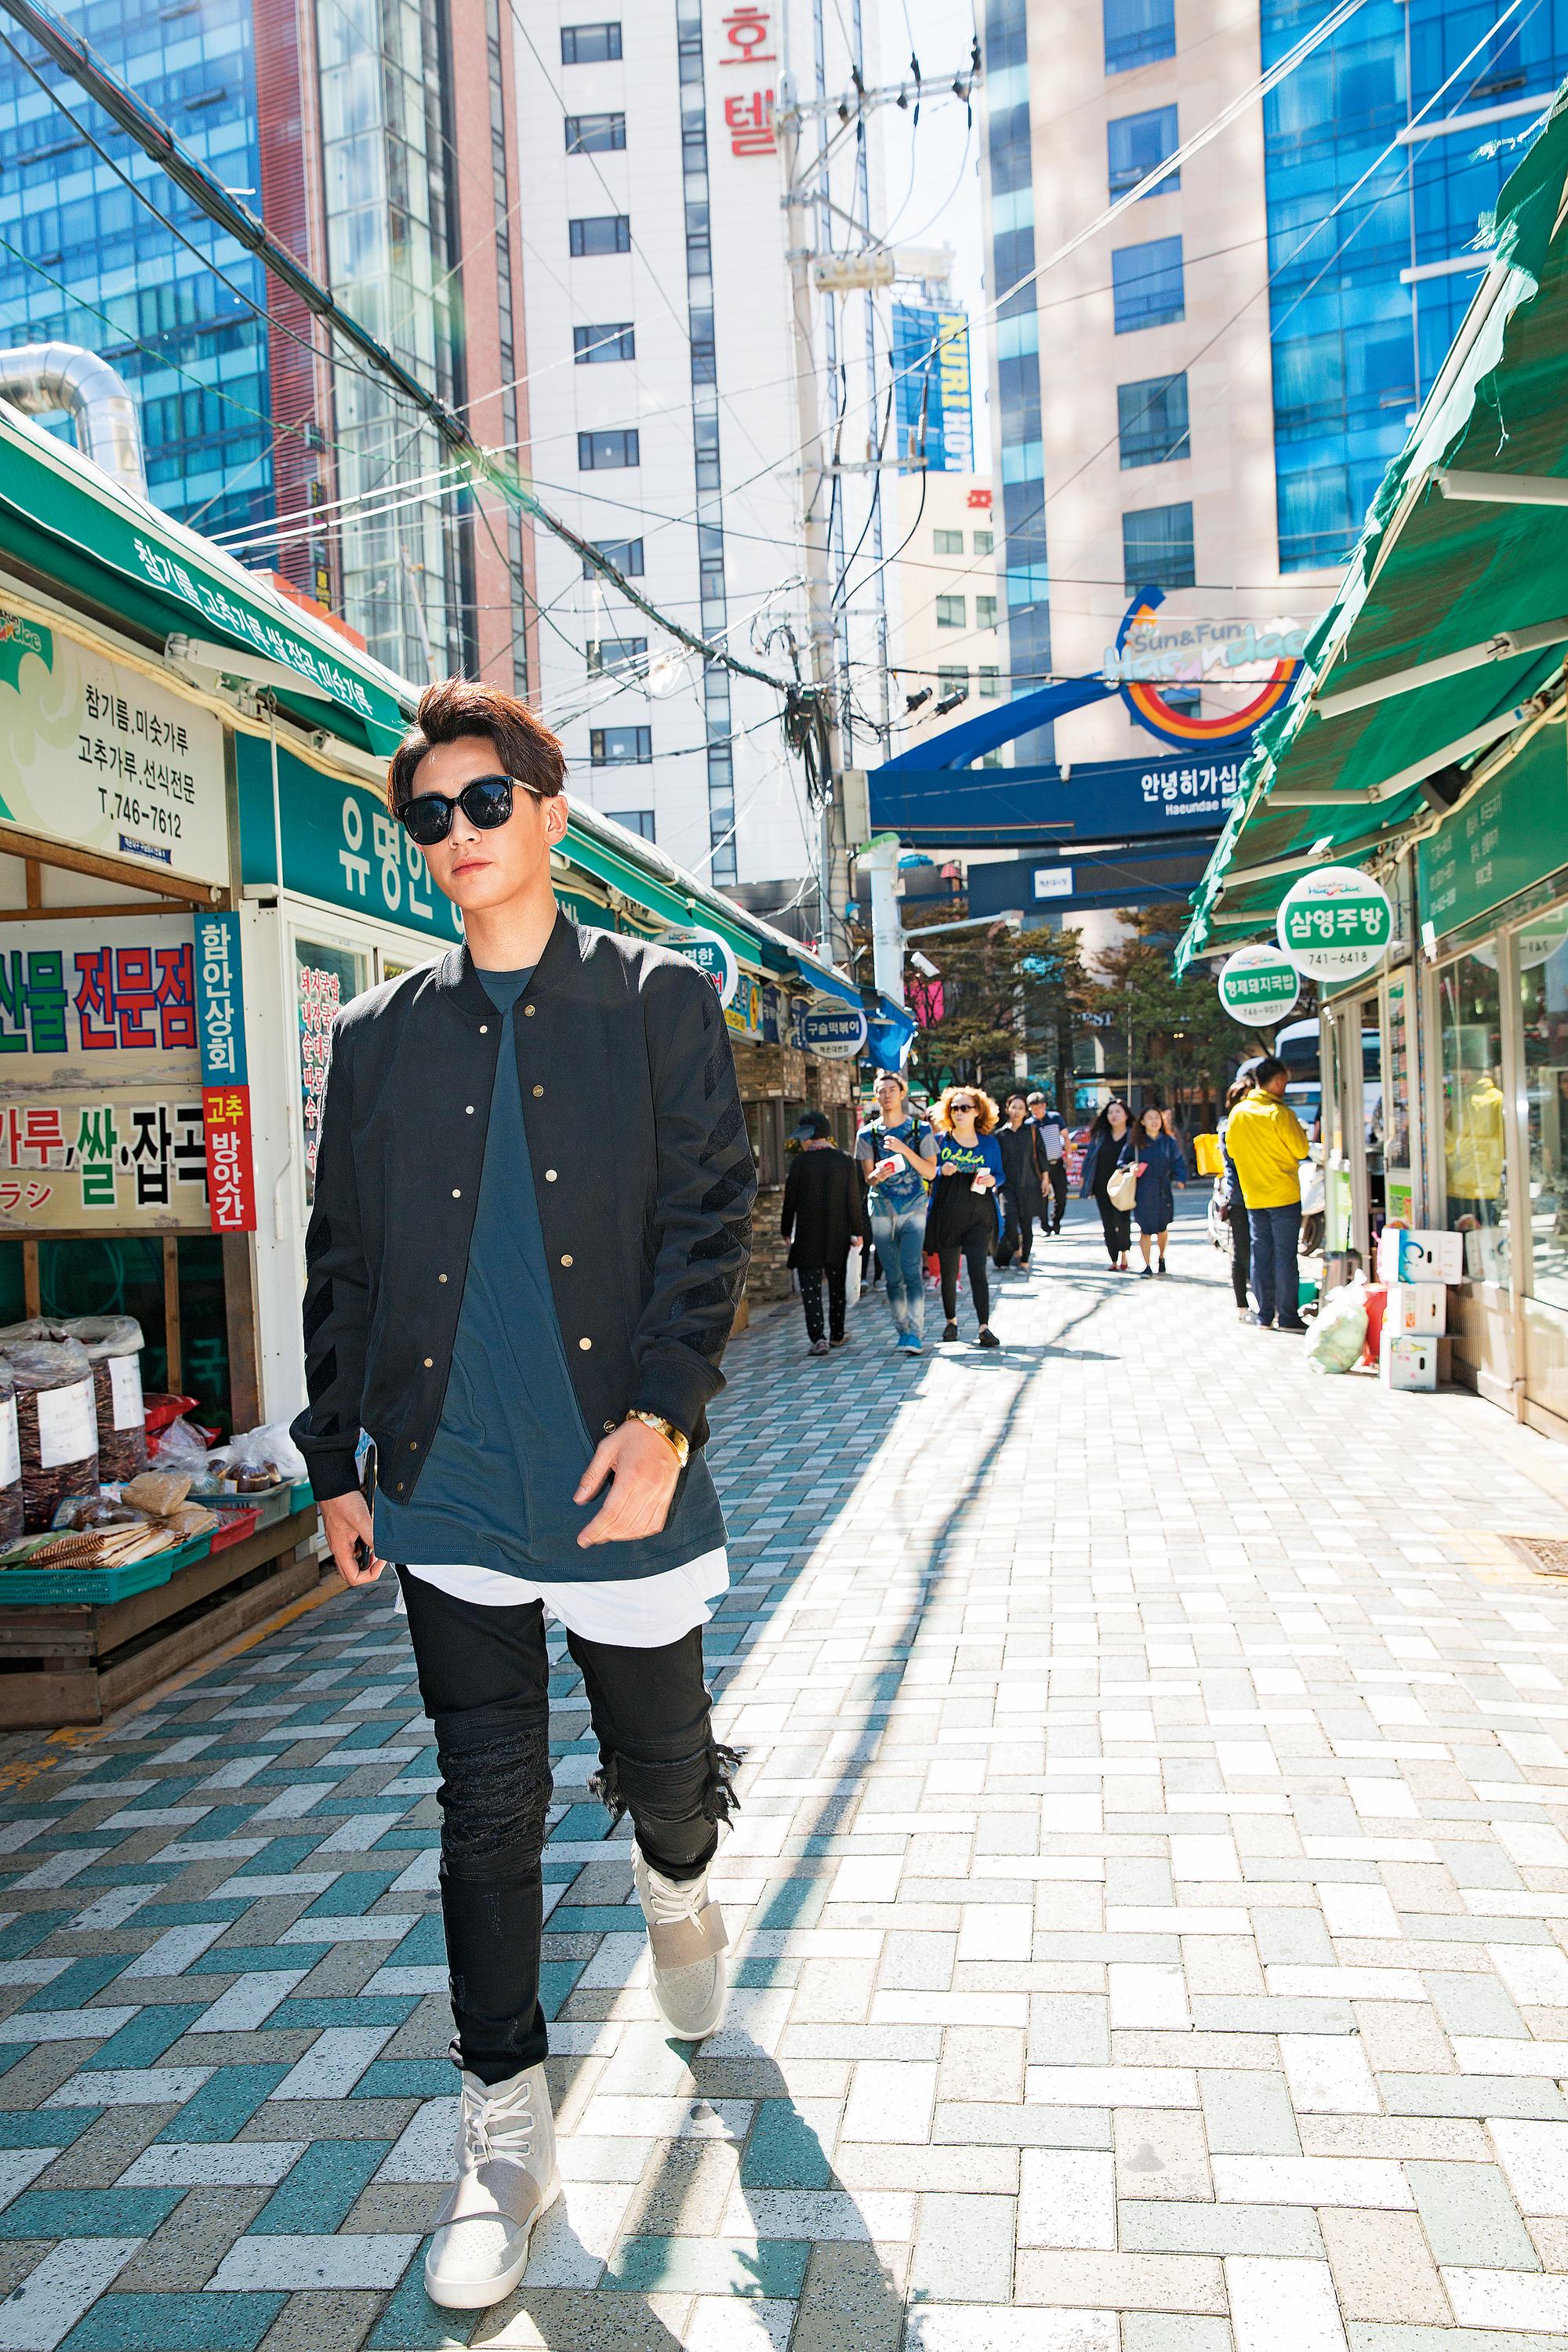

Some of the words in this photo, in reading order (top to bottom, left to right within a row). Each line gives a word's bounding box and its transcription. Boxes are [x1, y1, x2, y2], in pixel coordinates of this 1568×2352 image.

[720, 7, 776, 157] 호텔
[938, 314, 971, 408] NURI
[1134, 624, 1242, 652] Sun&Fun
[1165, 800, 1219, 816] Haeundae
[1290, 907, 1384, 938] 삼영주방
[681, 947, 714, 966] 명한
[1308, 952, 1368, 965] 741-6418
[74, 943, 198, 1050] 전문점
[201, 923, 235, 1074] 함안상회
[301, 967, 339, 1001] 돼지국밥
[1225, 975, 1294, 998] 형제돼지국밥
[208, 1095, 244, 1125] 고추
[212, 1132, 244, 1226] 방앗간
